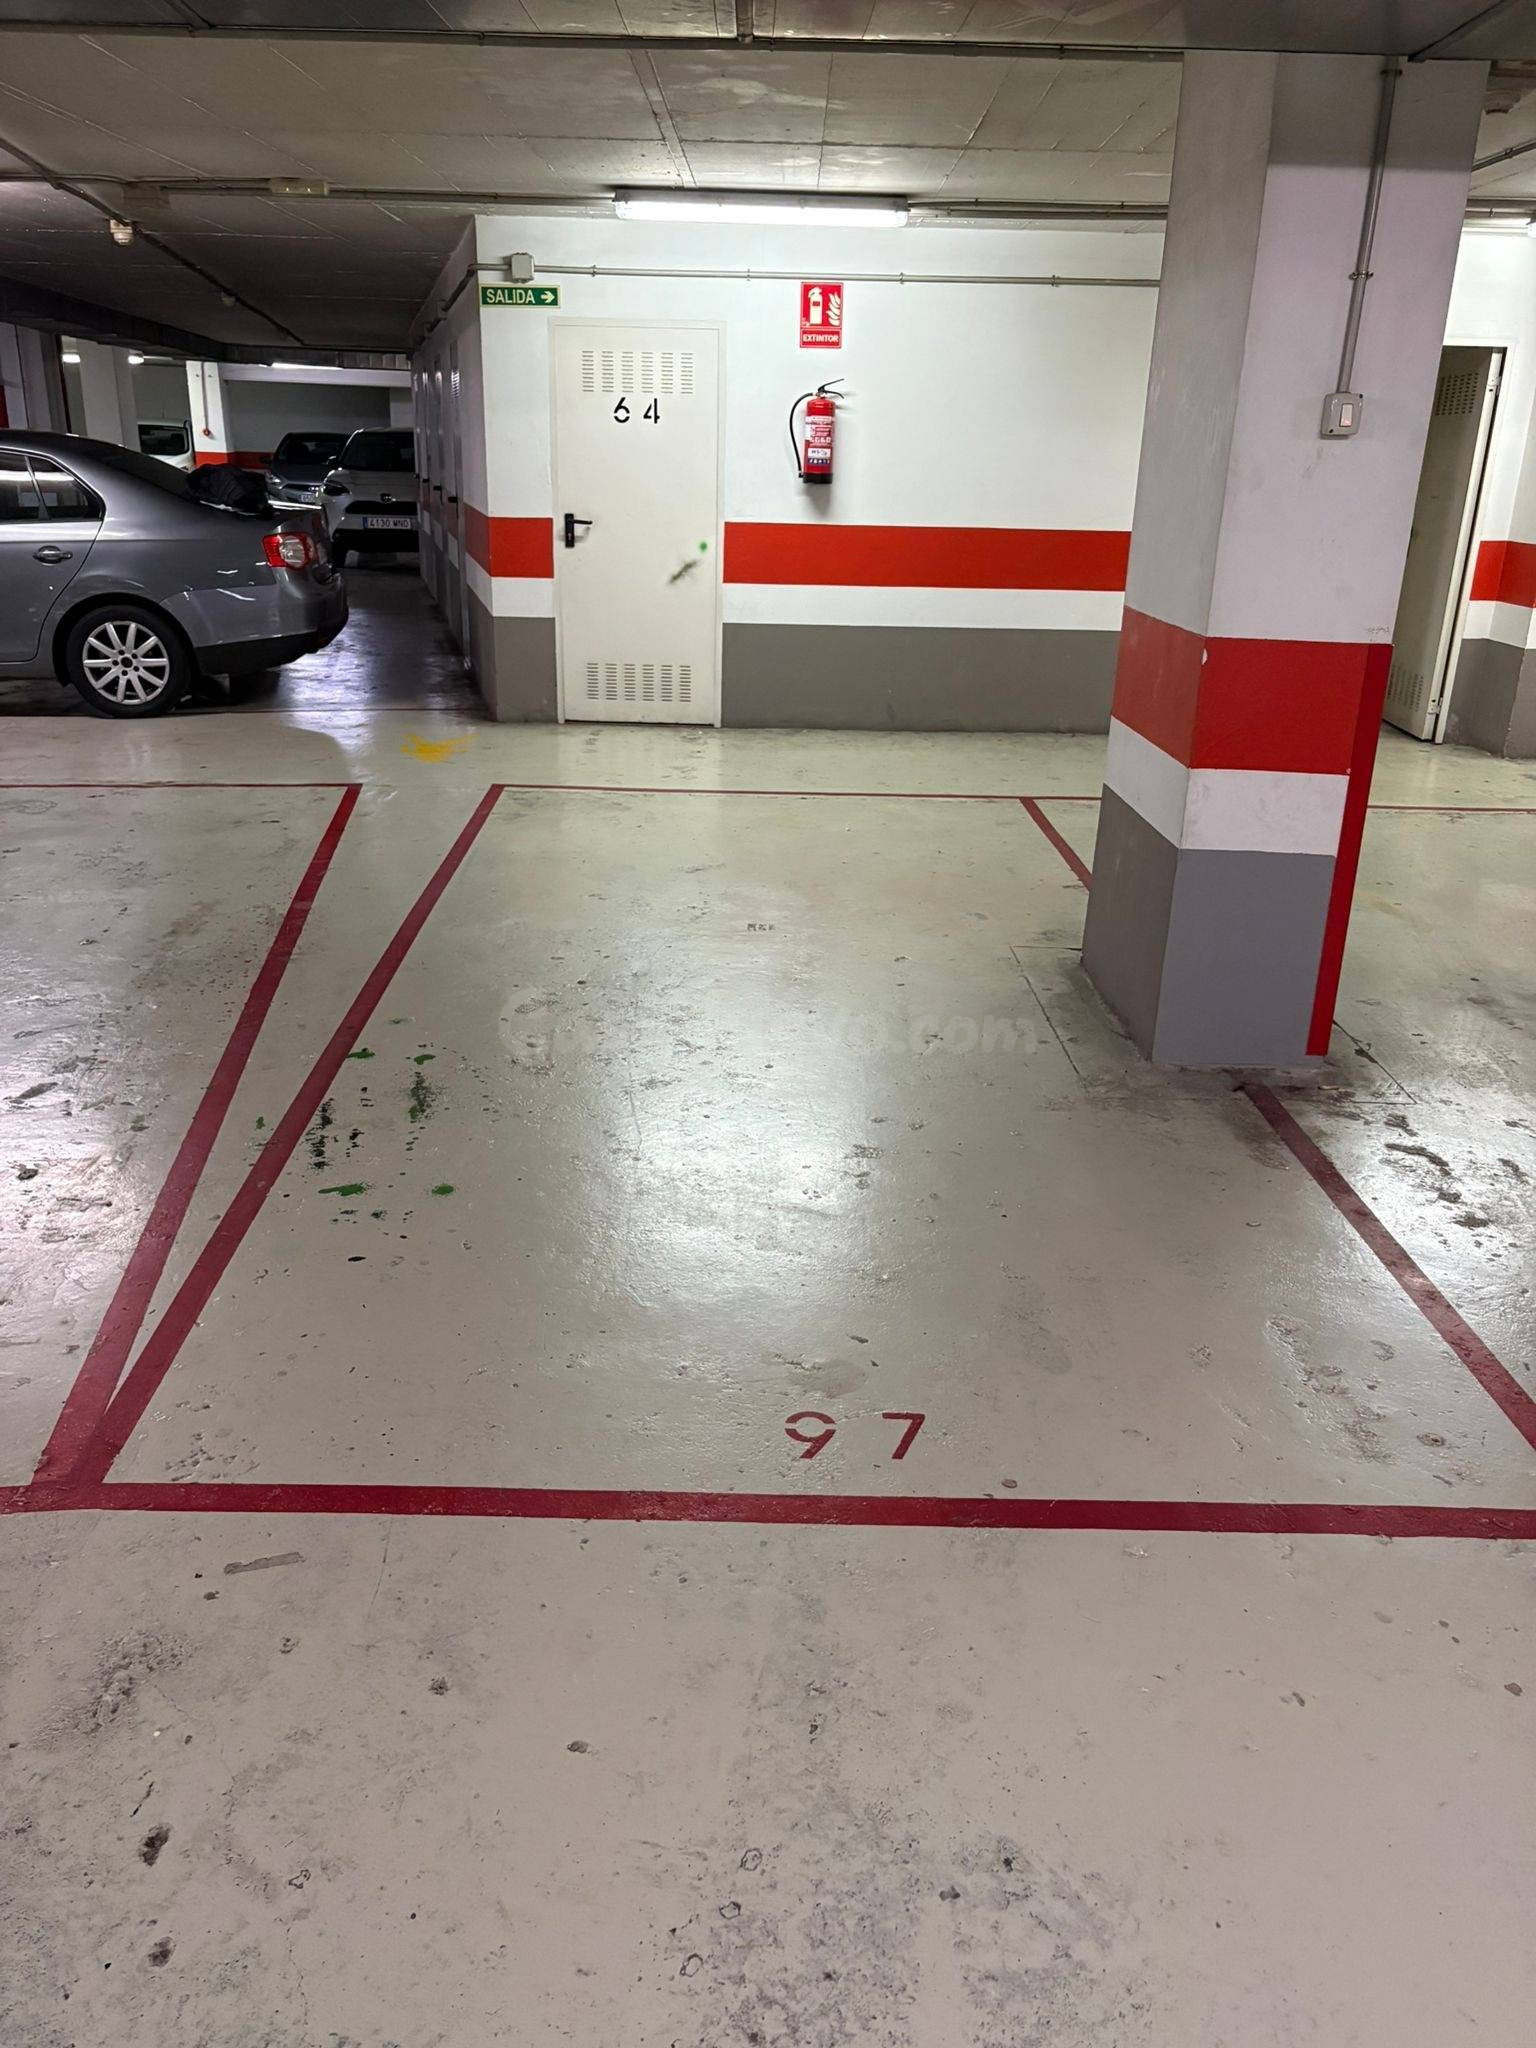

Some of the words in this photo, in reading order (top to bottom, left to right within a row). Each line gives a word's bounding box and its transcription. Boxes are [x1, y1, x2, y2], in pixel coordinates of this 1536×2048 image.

[486, 288, 536, 304] SALIDA
[802, 333, 839, 343] EXTINTOR
[613, 396, 661, 424] 64
[784, 1410, 926, 1460] 97
